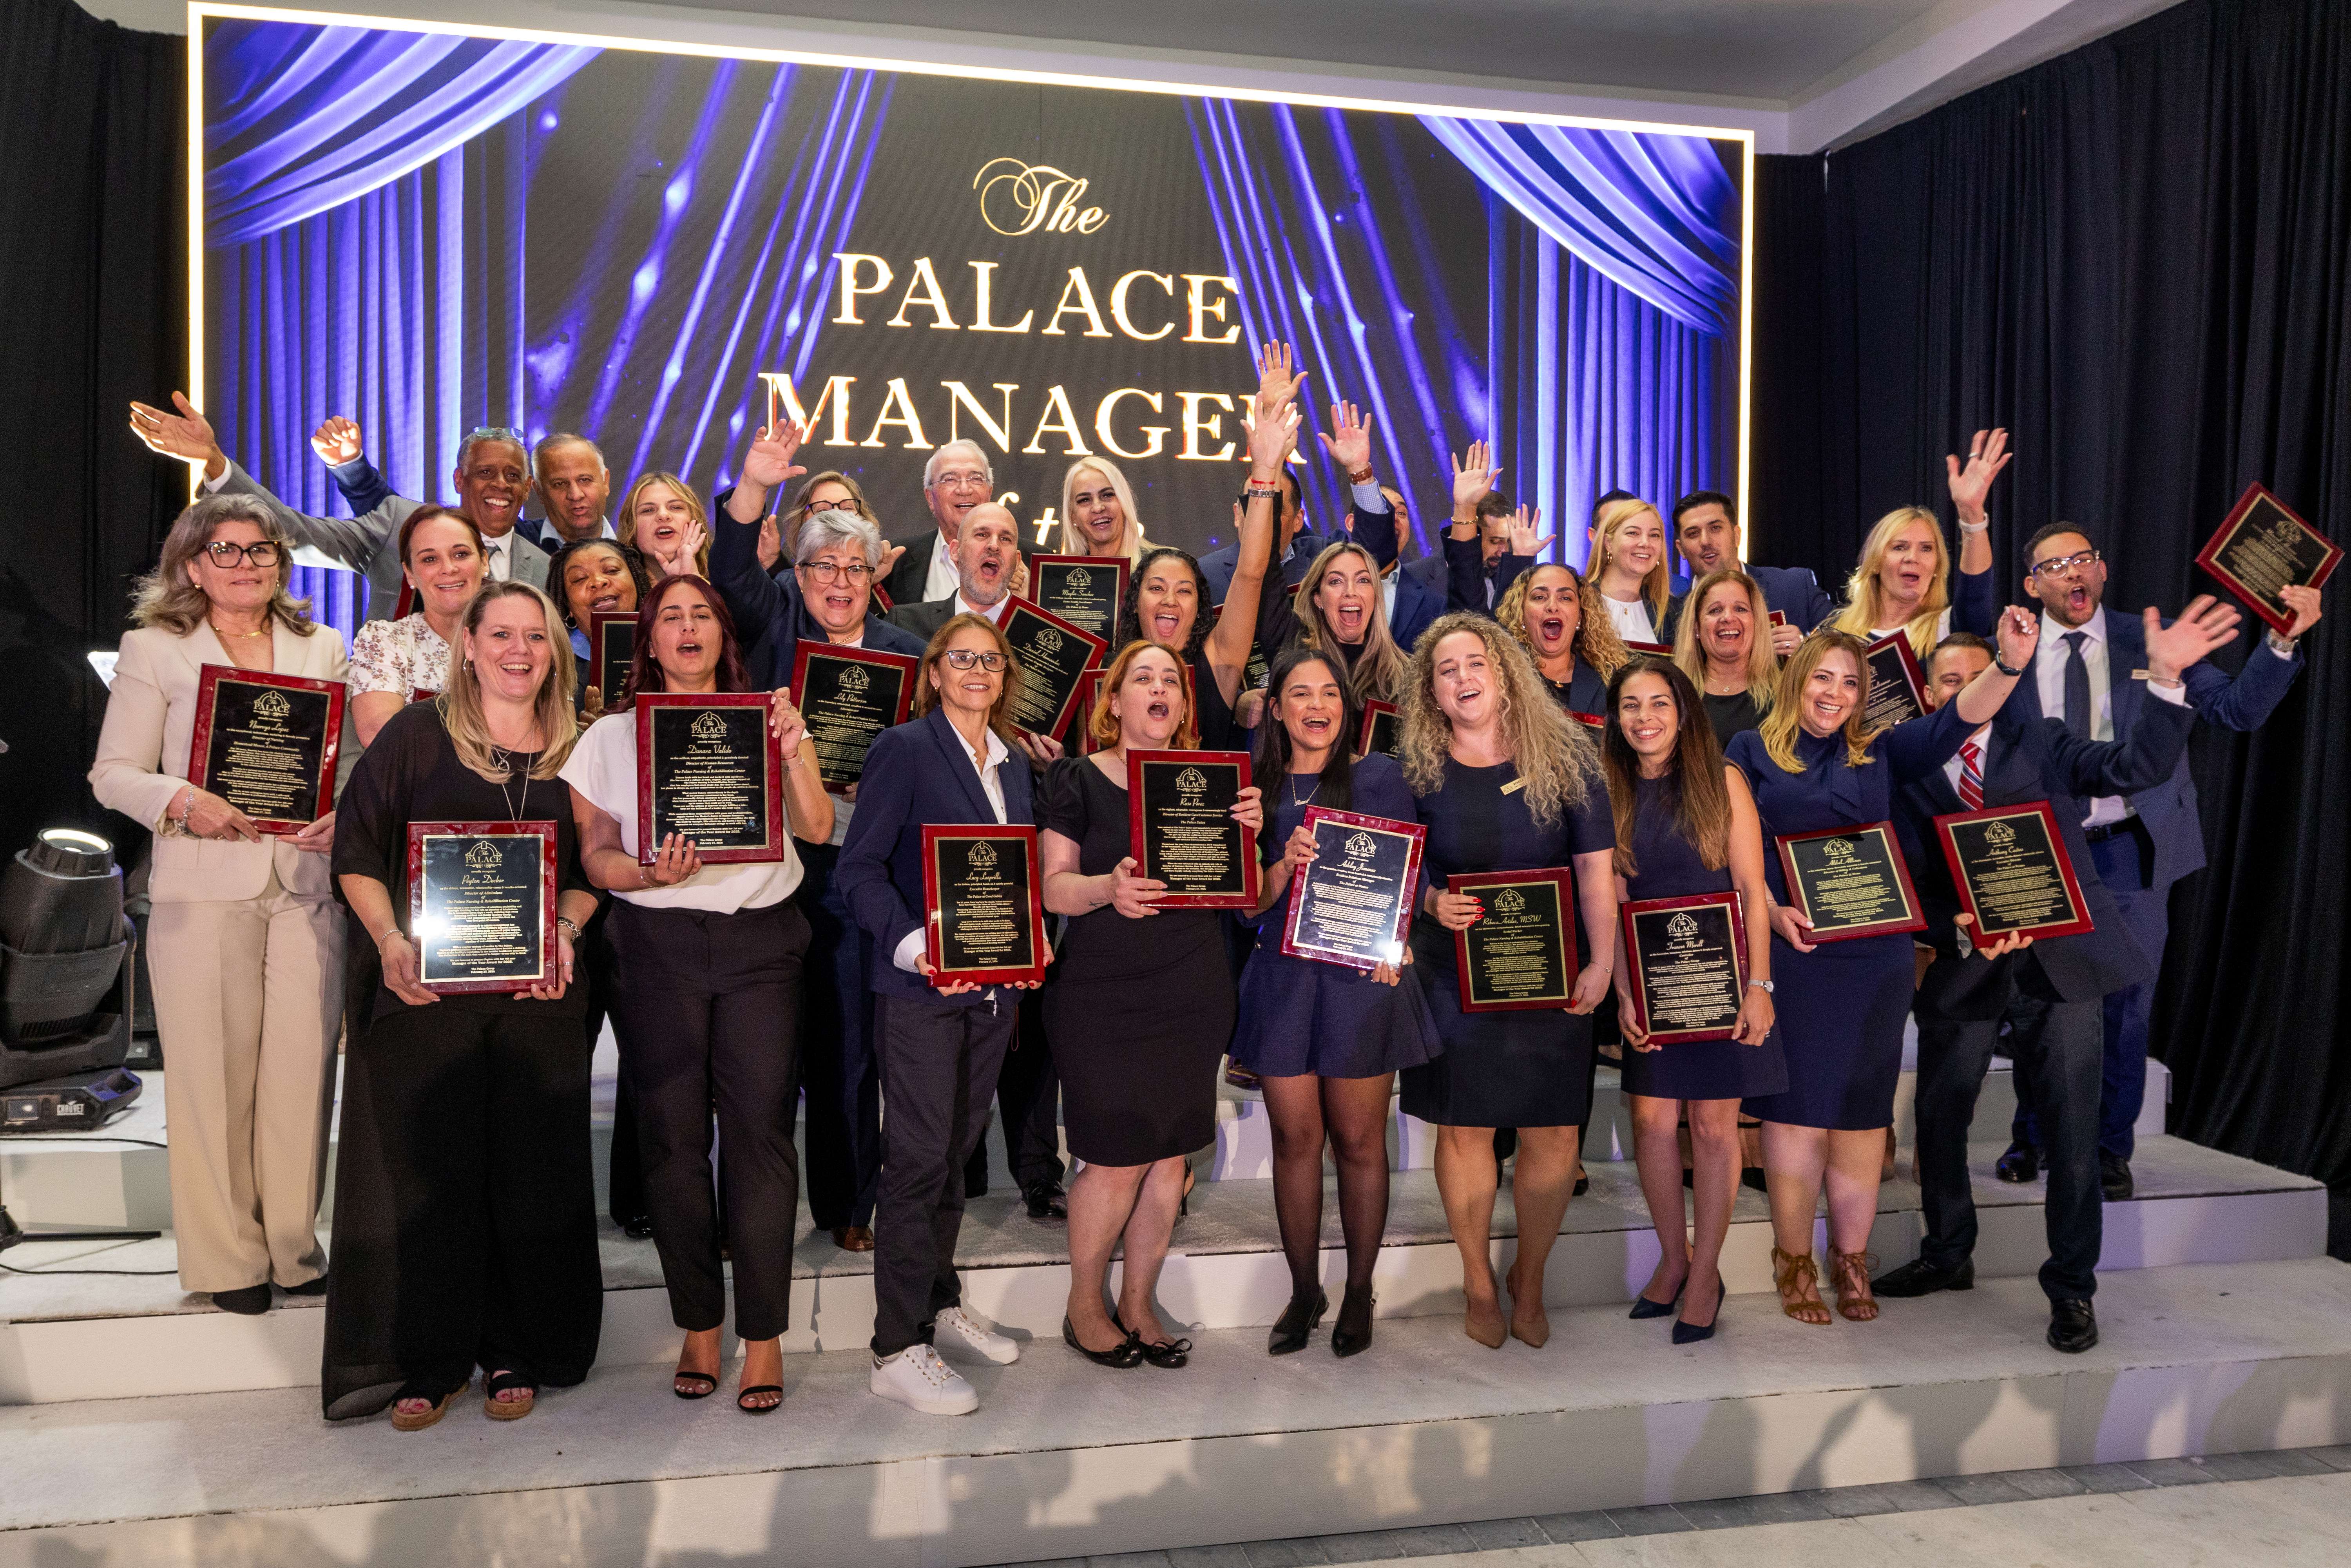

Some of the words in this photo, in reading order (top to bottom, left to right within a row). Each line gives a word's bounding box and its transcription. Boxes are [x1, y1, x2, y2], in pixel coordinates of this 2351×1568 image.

[973, 158, 1110, 236] The
[833, 253, 1241, 344] PALACE
[1036, 634, 1062, 649] PALACE
[1023, 643, 1041, 656] Daniel
[1040, 652, 1060, 666] Hernandez
[839, 676, 869, 686] PALACE
[834, 692, 846, 702] Lily
[846, 694, 867, 703] Patterson
[254, 703, 289, 713] PALACE
[687, 745, 711, 754] Danara
[714, 745, 732, 753] Valido
[1192, 798, 1204, 806] Perez
[1345, 843, 1376, 854] PALACE
[1337, 860, 1357, 871] Ashley
[1356, 862, 1376, 873] Jimenez
[462, 875, 480, 885] Peyton
[482, 874, 504, 883] Decker
[966, 872, 979, 882] Lucy
[980, 872, 1001, 882] Lasprilla
[1520, 915, 1541, 923] MSW
[1668, 925, 1698, 933] PALACE
